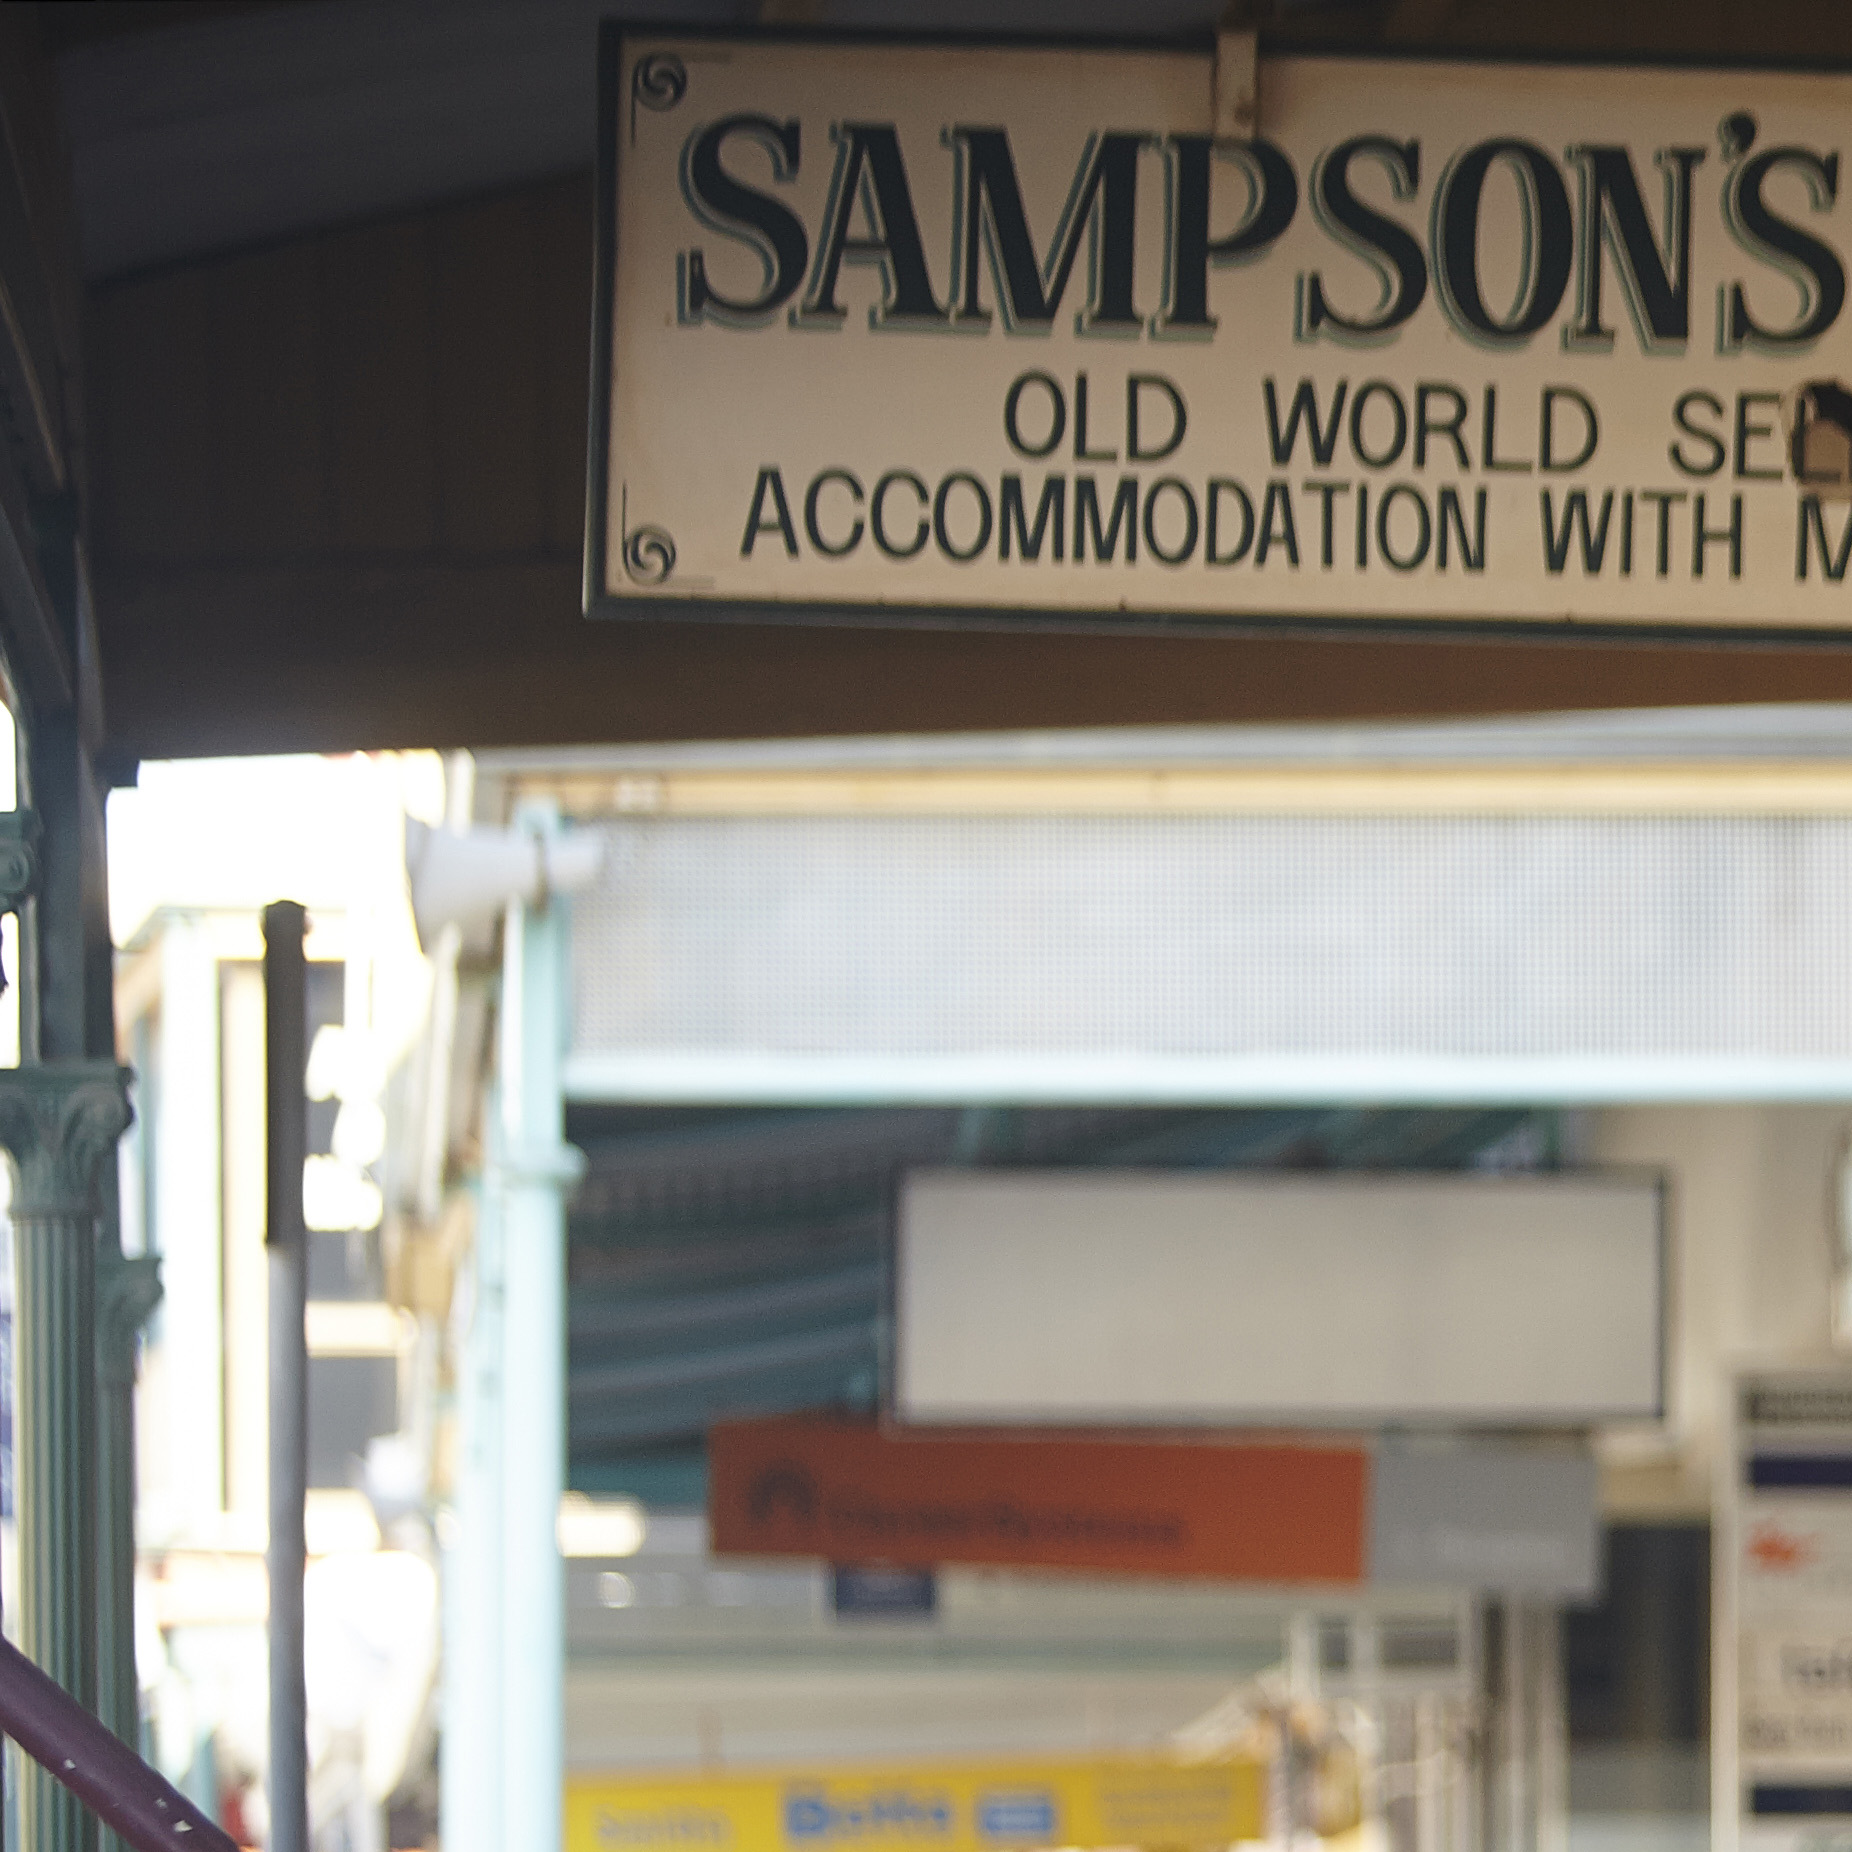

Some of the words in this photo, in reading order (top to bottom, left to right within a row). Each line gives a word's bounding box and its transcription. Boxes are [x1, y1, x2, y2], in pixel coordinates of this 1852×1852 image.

[677, 112, 1847, 354] SAMPSON'S
[1003, 370, 1188, 464] OLD
[1262, 376, 1600, 473] WORLD
[740, 466, 1490, 572] ACCOMMODATION
[1538, 488, 1742, 578] WITH
